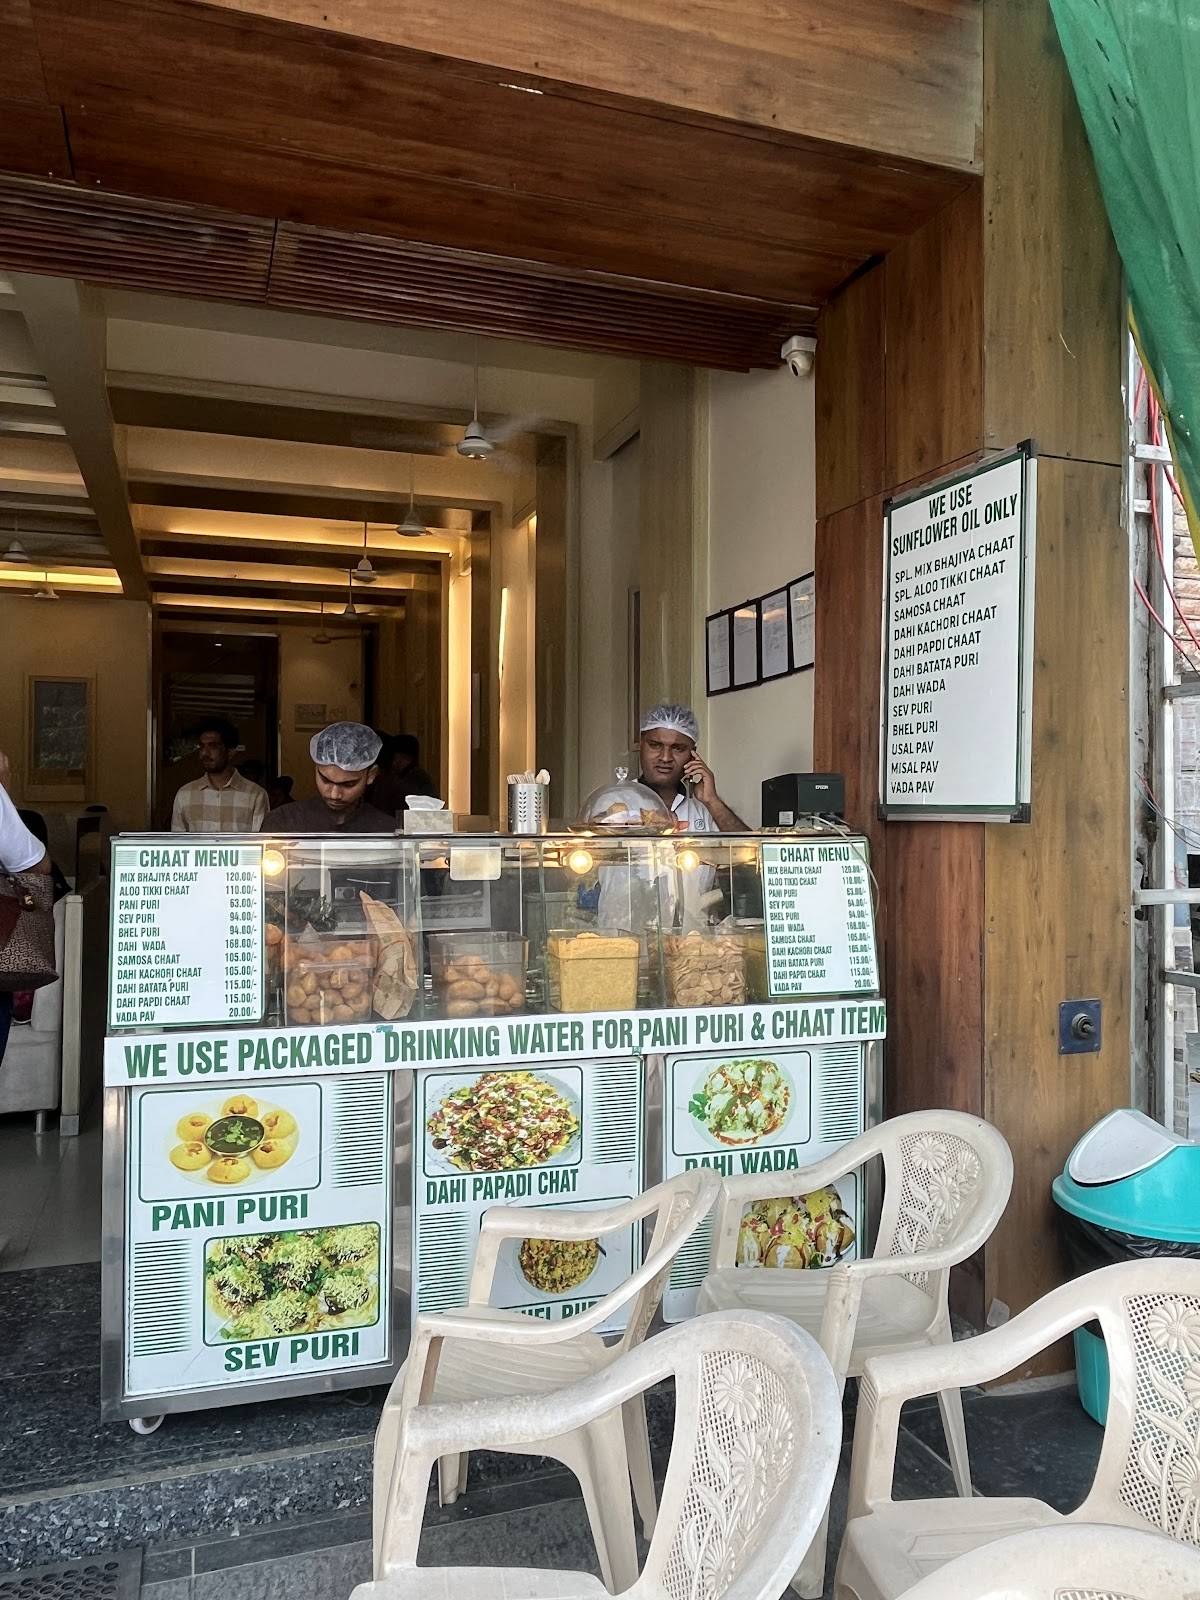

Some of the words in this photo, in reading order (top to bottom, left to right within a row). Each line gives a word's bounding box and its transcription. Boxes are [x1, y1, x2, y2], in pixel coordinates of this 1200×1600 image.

[928, 494, 946, 519] WE
[950, 483, 973, 511] USE
[892, 515, 957, 557] SUNFLOWER
[961, 508, 981, 533] OIL
[984, 493, 1018, 525] ONLY
[894, 569, 913, 584] SPL.
[914, 561, 932, 578] MIX
[934, 548, 976, 572] BHAJIYA
[978, 535, 1015, 558] CHAAT
[894, 588, 912, 603] SPL.
[914, 579, 938, 597] ALOO
[940, 571, 968, 590] TIKKI
[969, 560, 1006, 582] CHAAT
[894, 602, 932, 622] SAMOSA
[934, 592, 966, 611] CHAAT
[894, 625, 915, 641] DAHI
[917, 616, 960, 636] KACHORI
[962, 605, 998, 625] CHAAT
[894, 645, 915, 660] DAHI
[917, 638, 945, 655] PAPDI
[947, 630, 981, 649] CHAAT
[893, 665, 915, 679] DAHI
[916, 657, 952, 675] BATATA
[955, 652, 979, 667] PURI
[893, 684, 914, 699] DAHI
[916, 679, 946, 695] WADA
[893, 704, 909, 717] SEV
[911, 701, 932, 715] PURI
[892, 723, 914, 736] BHEL
[916, 720, 938, 734] PURI
[891, 743, 914, 755] USAL
[916, 740, 934, 754] PAV
[891, 761, 918, 775] MISAL
[920, 760, 940, 774] PAV
[891, 781, 914, 794] VADA
[916, 780, 935, 794] PAV
[139, 850, 190, 867] CHAAT
[194, 849, 239, 867] MENU
[120, 873, 136, 882] MIX
[137, 872, 171, 882] BHAJIYA
[173, 872, 199, 882] CHAAT
[225, 872, 257, 882] 120.00/-
[119, 886, 140, 896] ALOO
[142, 886, 162, 896] TIKKI
[164, 885, 190, 895] CHAAT
[225, 885, 257, 895] 110.00/-
[119, 900, 138, 910] PANI
[140, 899, 160, 910] PURI
[229, 898, 257, 908] 63.00/-
[118, 914, 134, 924] SEV
[135, 913, 155, 923] PURI
[229, 912, 257, 922] 94.00/-
[118, 927, 138, 938] BHEL
[140, 927, 160, 937] PURI
[229, 925, 257, 935] 94.00/-
[118, 941, 137, 952] DAHI
[142, 941, 166, 951] WADA
[225, 939, 257, 949] 168.00/-
[117, 955, 152, 966] SAMOSA
[154, 954, 181, 964] CHAAT
[225, 952, 257, 963] 105.00/-
[117, 969, 137, 979] DAHI
[139, 968, 174, 979] KACHORI
[176, 967, 202, 978] CHAAT
[225, 966, 257, 976] 105.00/-
[117, 983, 136, 994] DAHI
[138, 982, 167, 993] BATATA
[169, 982, 189, 992] PURI
[225, 980, 257, 990] 115.00/-
[116, 997, 136, 1008] DAHI
[138, 997, 162, 1007] PAPDI
[164, 996, 191, 1006] CHAAT
[225, 993, 257, 1004] 115.00/-
[116, 1011, 138, 1022] VADA
[140, 1011, 155, 1021] PAV
[228, 1008, 257, 1017] 20.00/-
[124, 1043, 168, 1079] WE
[177, 1040, 229, 1075] USE
[238, 1032, 372, 1072] PACKAGED
[384, 1025, 500, 1062] DRINKING
[508, 1021, 584, 1055] WATER
[592, 1018, 633, 1051] FOR
[639, 1016, 687, 1049] PANI
[695, 1013, 743, 1045] PURI
[751, 1010, 765, 1040] &
[771, 1008, 835, 1039] CHAAT
[840, 1006, 885, 1035] ITEM
[740, 1148, 799, 1175] WADA
[426, 1178, 467, 1205] DAHI
[472, 1174, 532, 1202] PAPADI
[538, 1168, 579, 1195] CHAT
[152, 1201, 224, 1231] PANI
[237, 1193, 309, 1224] PURI
[224, 1340, 279, 1372] SEV
[290, 1332, 359, 1364] PURI
